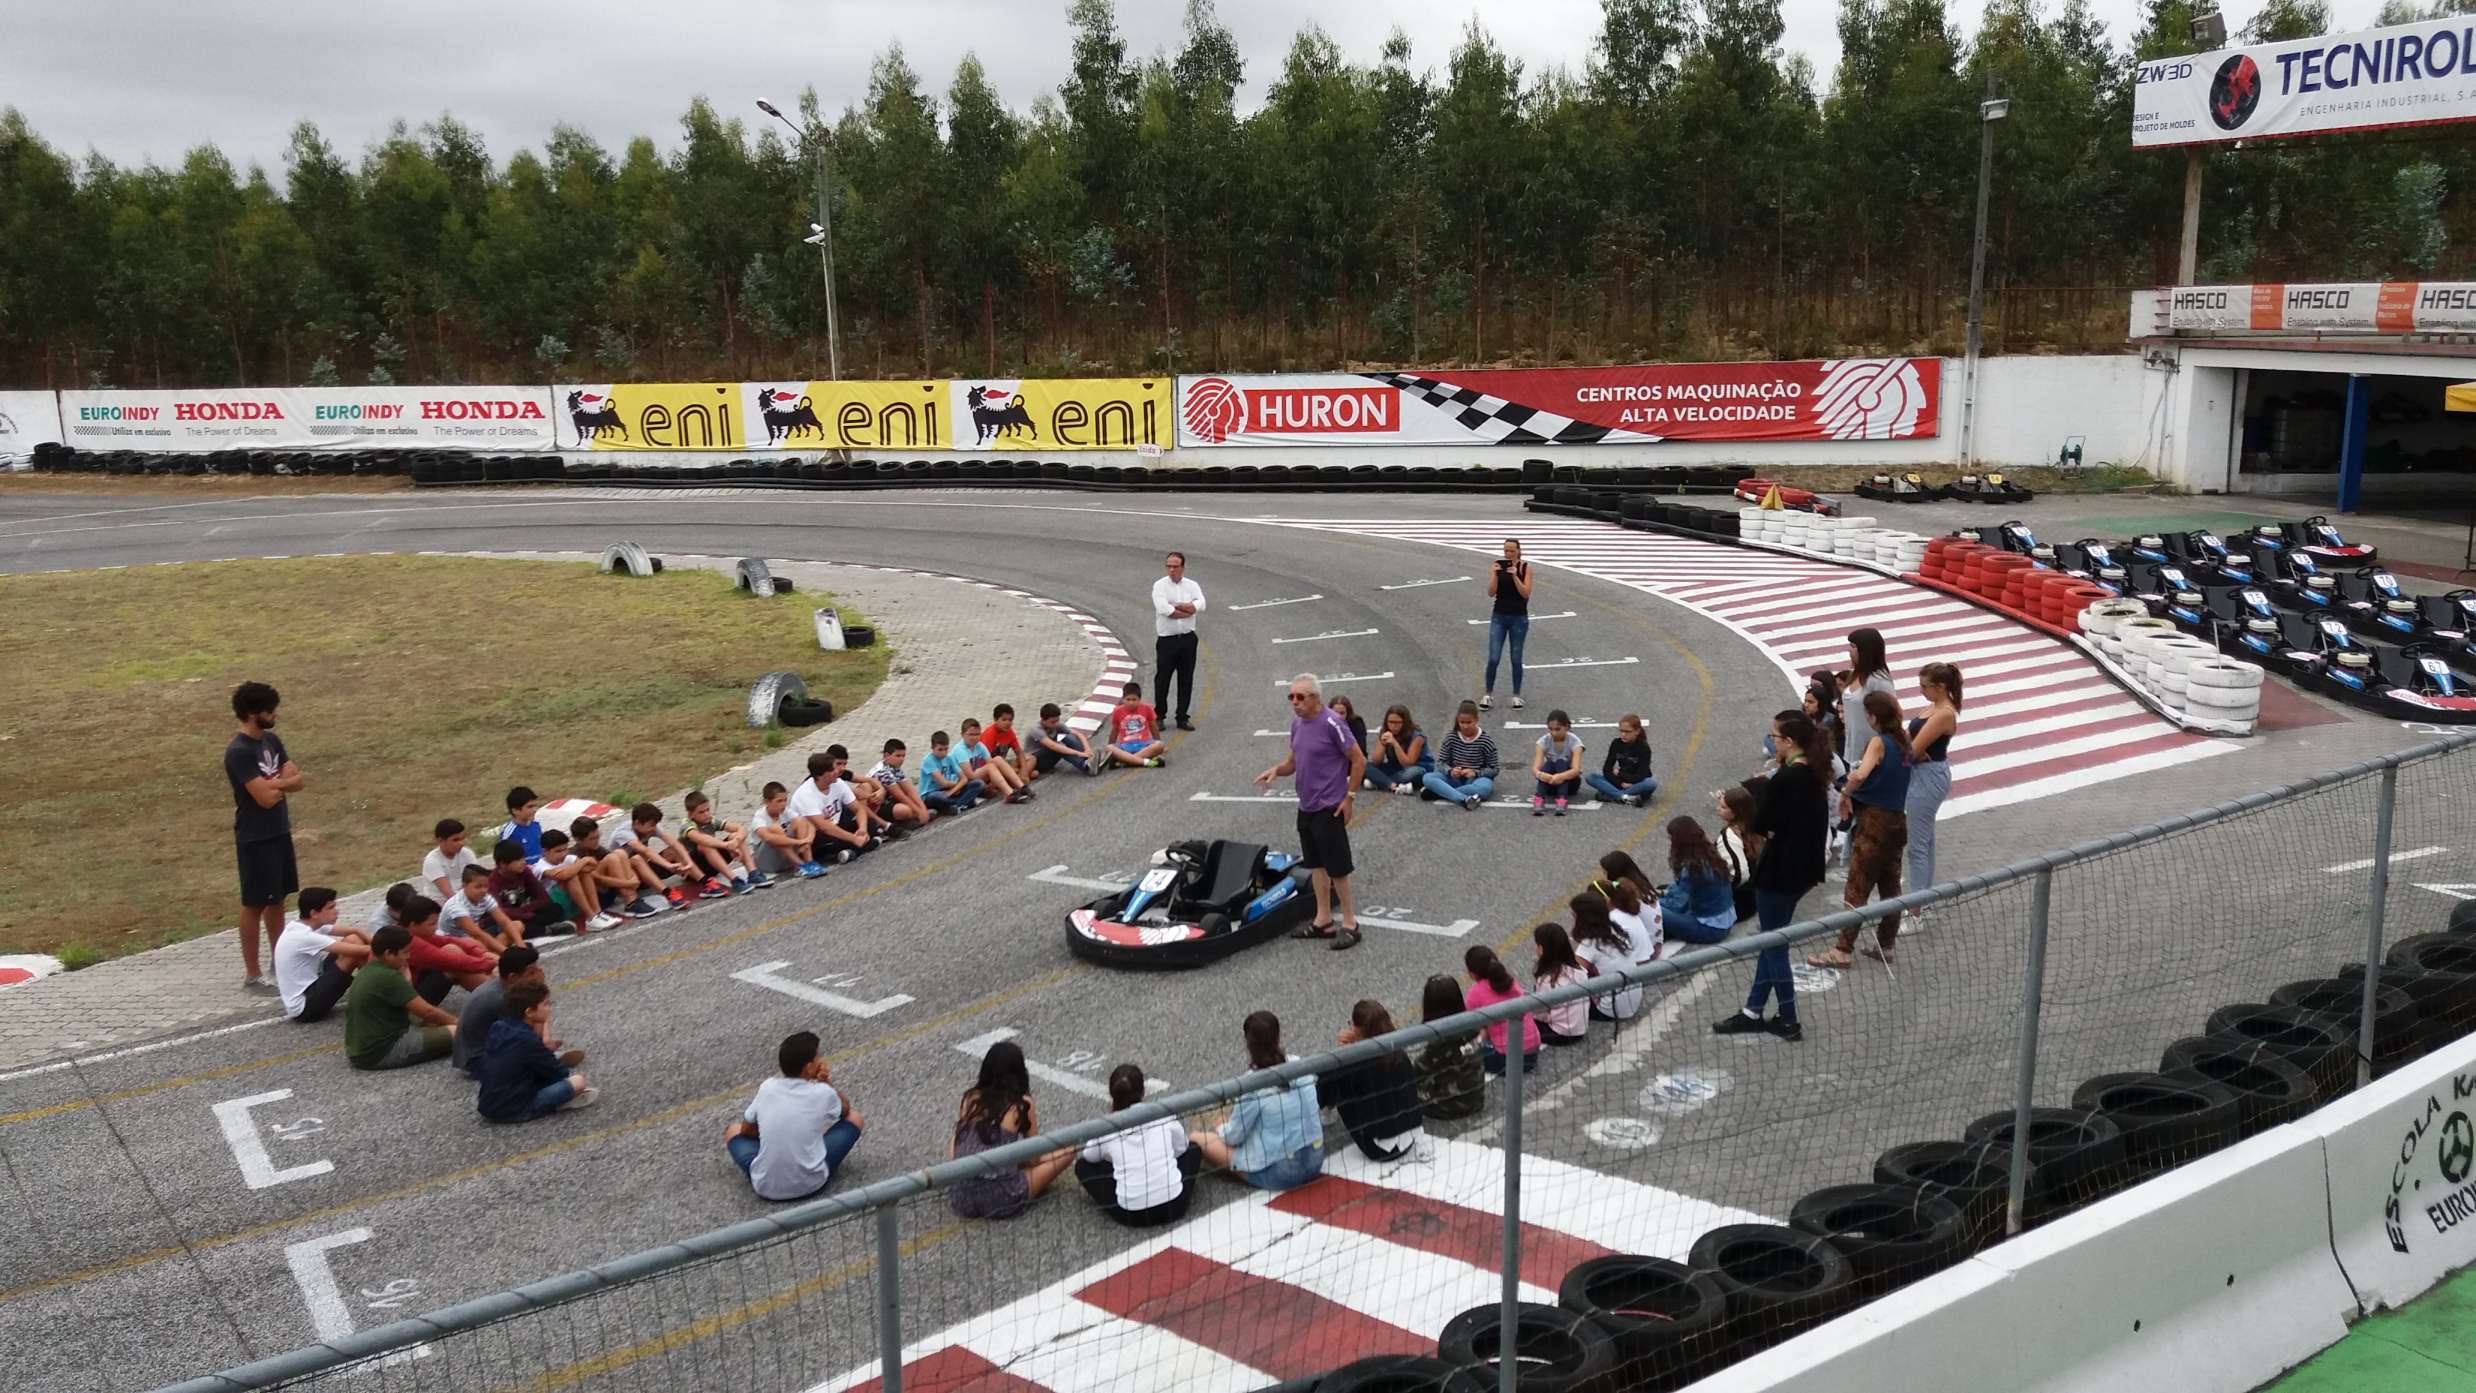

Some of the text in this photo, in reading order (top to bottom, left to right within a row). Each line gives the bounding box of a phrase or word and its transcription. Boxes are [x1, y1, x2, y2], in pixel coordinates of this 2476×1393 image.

[2276, 26, 2476, 96] TECNIROL
[2300, 99, 2372, 117] ENGENHARIA
[2159, 122, 2169, 131] DE
[2169, 119, 2196, 130] MOLDES
[2174, 292, 2228, 310] HASCO
[2287, 290, 2350, 310] HASCO
[2338, 317, 2369, 328] System
[1576, 378, 1801, 404] CENTROS MAQUINAÇÃO
[80, 402, 285, 421] EUROINDY HONDA
[315, 401, 546, 420] EUROINDY HONDA
[640, 386, 731, 448] eni
[837, 385, 938, 447] eni
[1051, 382, 1157, 447] eni
[1259, 391, 1388, 429] HURON
[1620, 403, 1797, 424] ALTA VELOCIDADE
[186, 426, 278, 437] The Power of Dreams
[434, 426, 452, 436] The
[455, 426, 485, 436] Power
[500, 426, 538, 436] Dreams
[2427, 660, 2442, 673] 67
[2385, 1094, 2442, 1254] ESCOLA
[360, 1278, 422, 1309] 16
